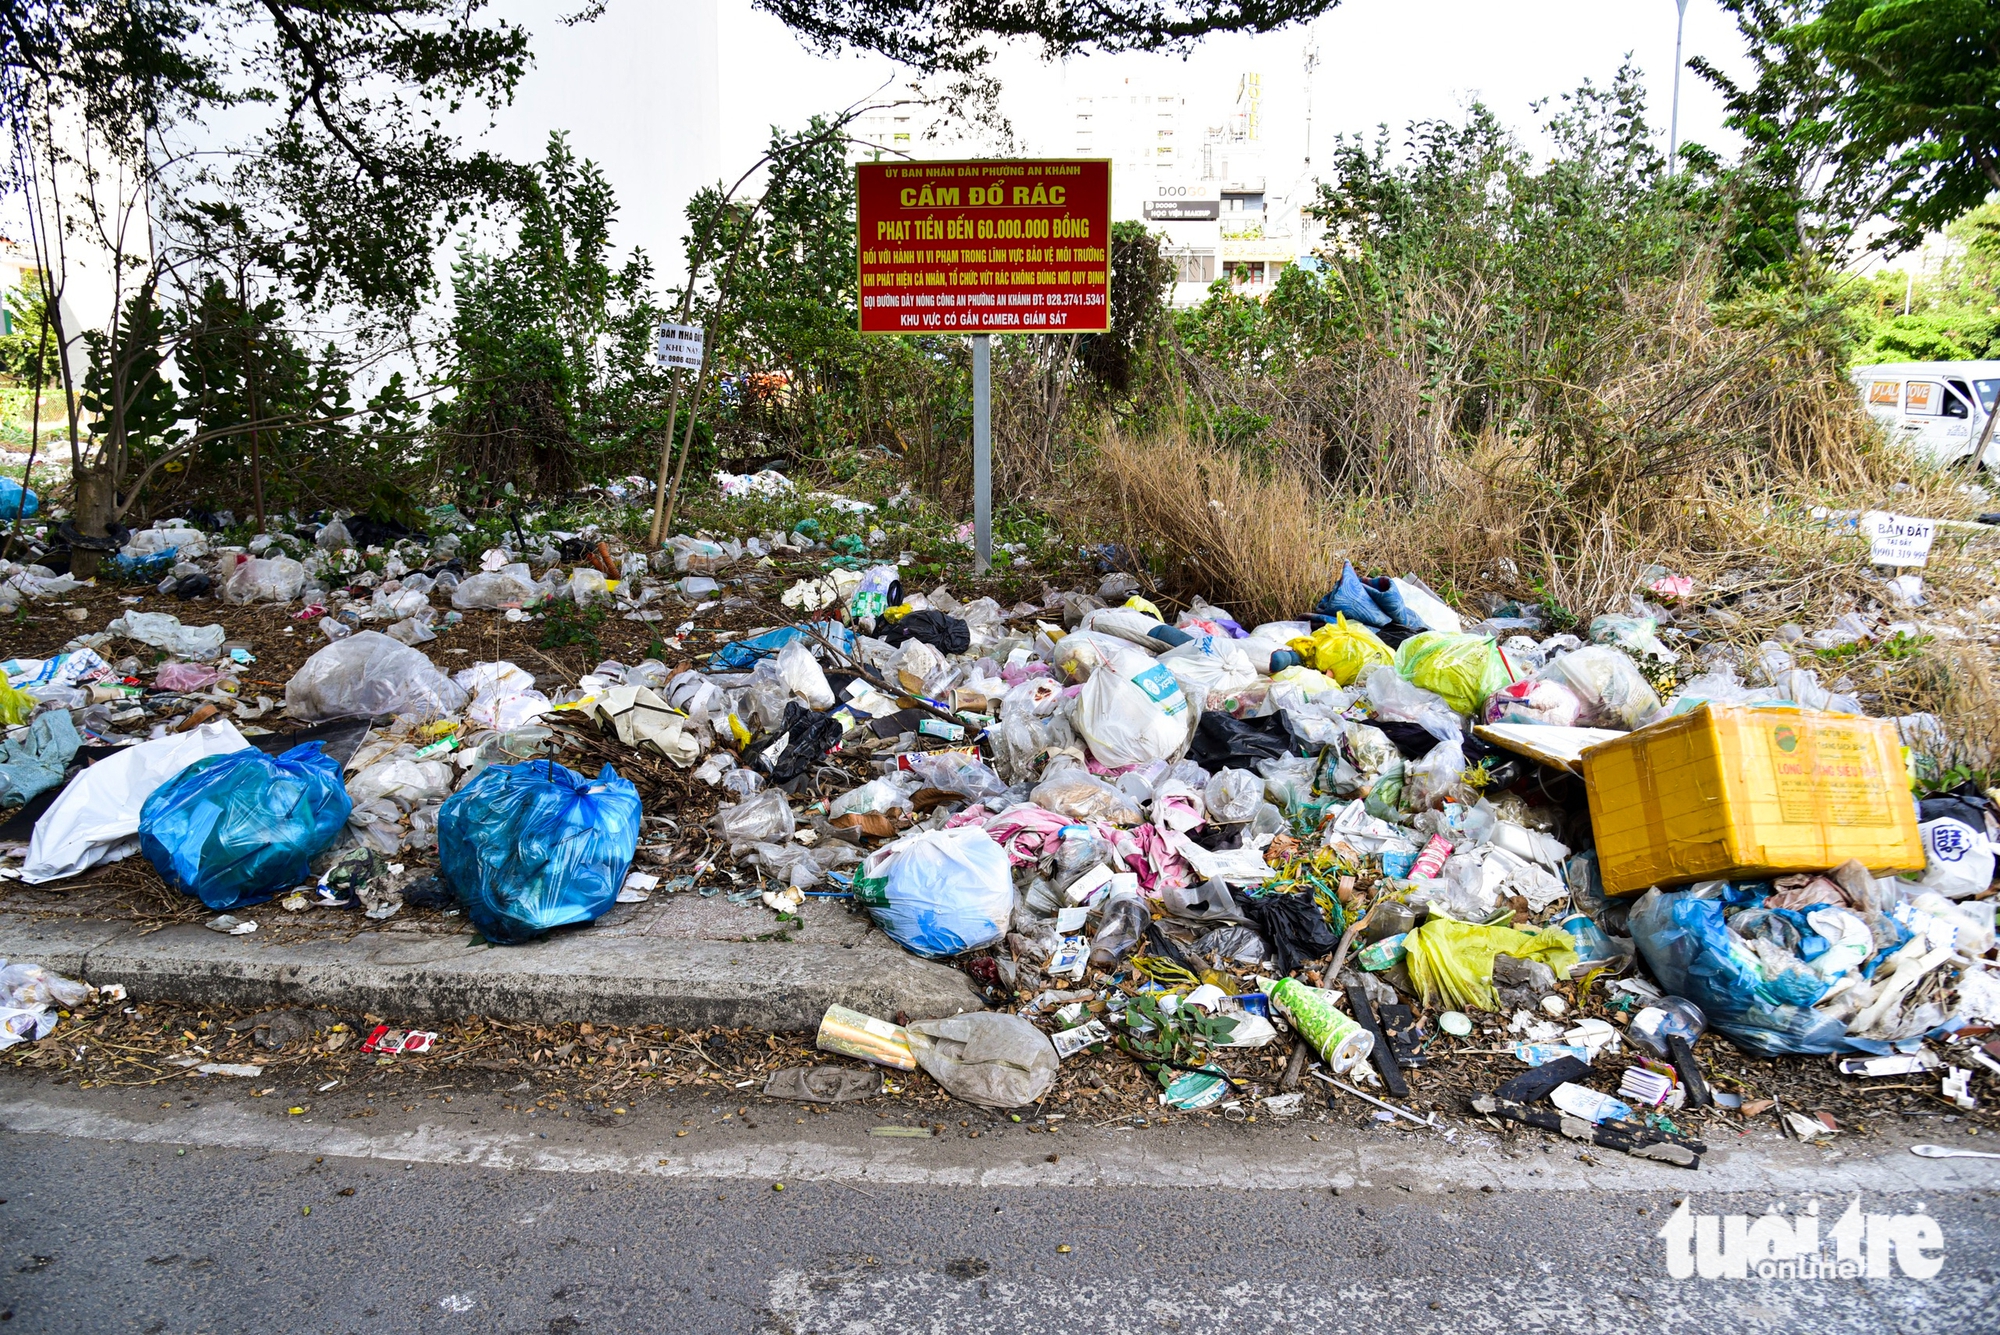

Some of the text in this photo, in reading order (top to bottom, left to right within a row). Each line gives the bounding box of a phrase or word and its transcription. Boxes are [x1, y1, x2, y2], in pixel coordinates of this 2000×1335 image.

[885, 164, 1081, 178] ỦY BAN NHÂN DÂN PHƯỜNG AN KHÁNH
[900, 179, 1066, 207] CẤM ĐỔ RÁC
[1158, 186, 1207, 197] DOOGO
[1150, 210, 1167, 218] HỌC
[1168, 208, 1183, 218] VIỆN
[877, 211, 1089, 245] PHẠT TIỀN ĐẾN 60.000.000 ĐỒNG
[863, 244, 1105, 266] ĐỐI VỚI HÀNH VI VI PHẠM TRONG LĨNH VỰC BẢO VỆ MÔI TRƯỜNG
[863, 267, 1105, 289] KHI PHÁT HIỆN CÁ NHÂN, TỔ CHỨC VỨT RÁC KHÔNG ĐÚNG NƠI QUY ĐỊNH
[863, 292, 1105, 310] GỌI ĐƯỜNG DÂY NÓNG CÔNG AN PHƯỜNG AN KHÁNH ĐT: 028.3741.5341
[900, 309, 1067, 329] KHU VỰC CÓ GẮN CAMERA GIÁM SÁT
[660, 327, 676, 339] BÁN
[1907, 523, 1930, 538] ĐẤT
[1936, 829, 1953, 853] STOP
